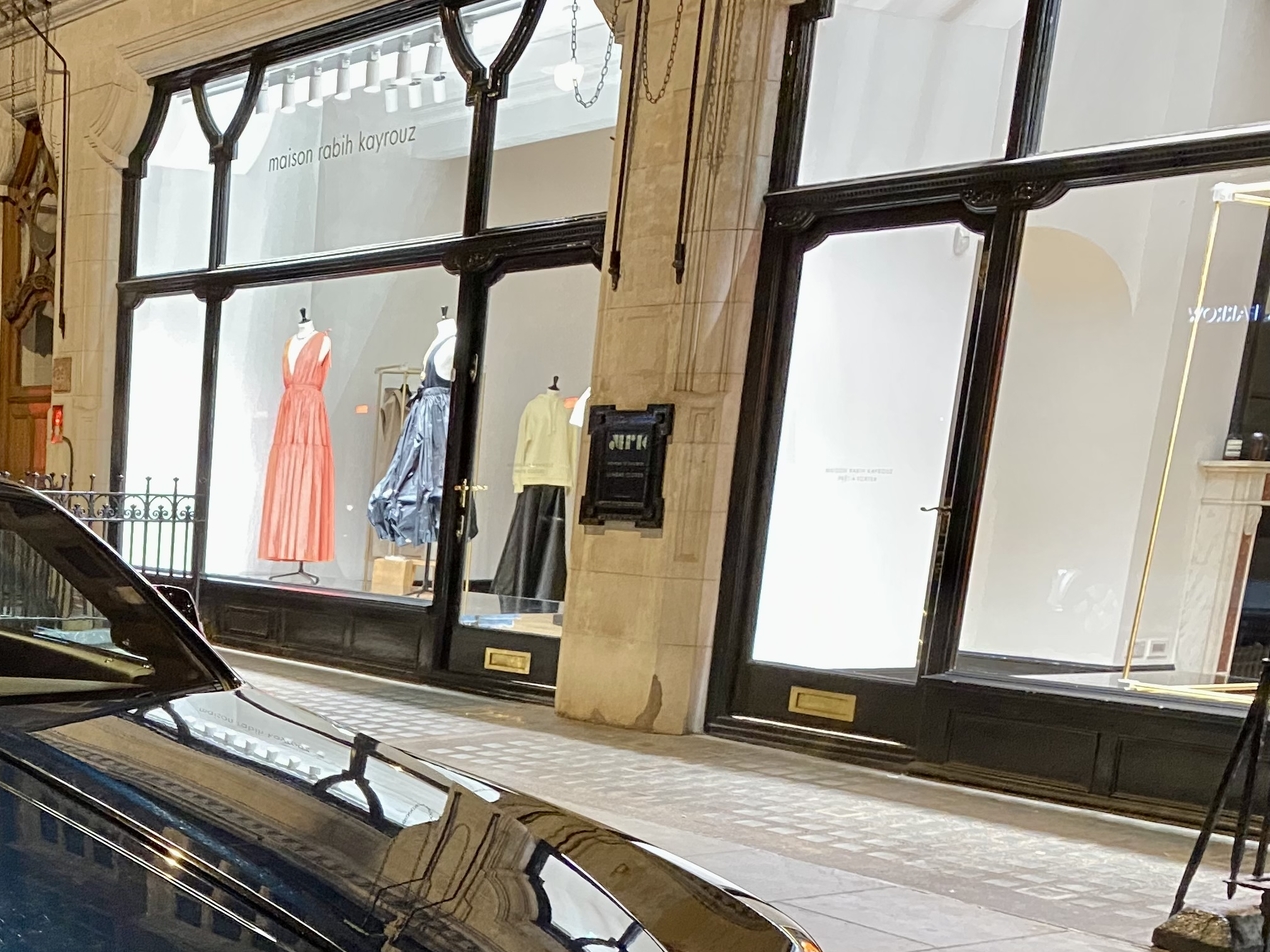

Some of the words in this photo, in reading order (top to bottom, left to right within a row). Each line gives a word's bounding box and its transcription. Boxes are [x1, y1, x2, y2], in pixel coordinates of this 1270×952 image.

[268, 147, 314, 173] maison
[318, 134, 353, 161] rabih
[358, 126, 417, 154] kayrouz
